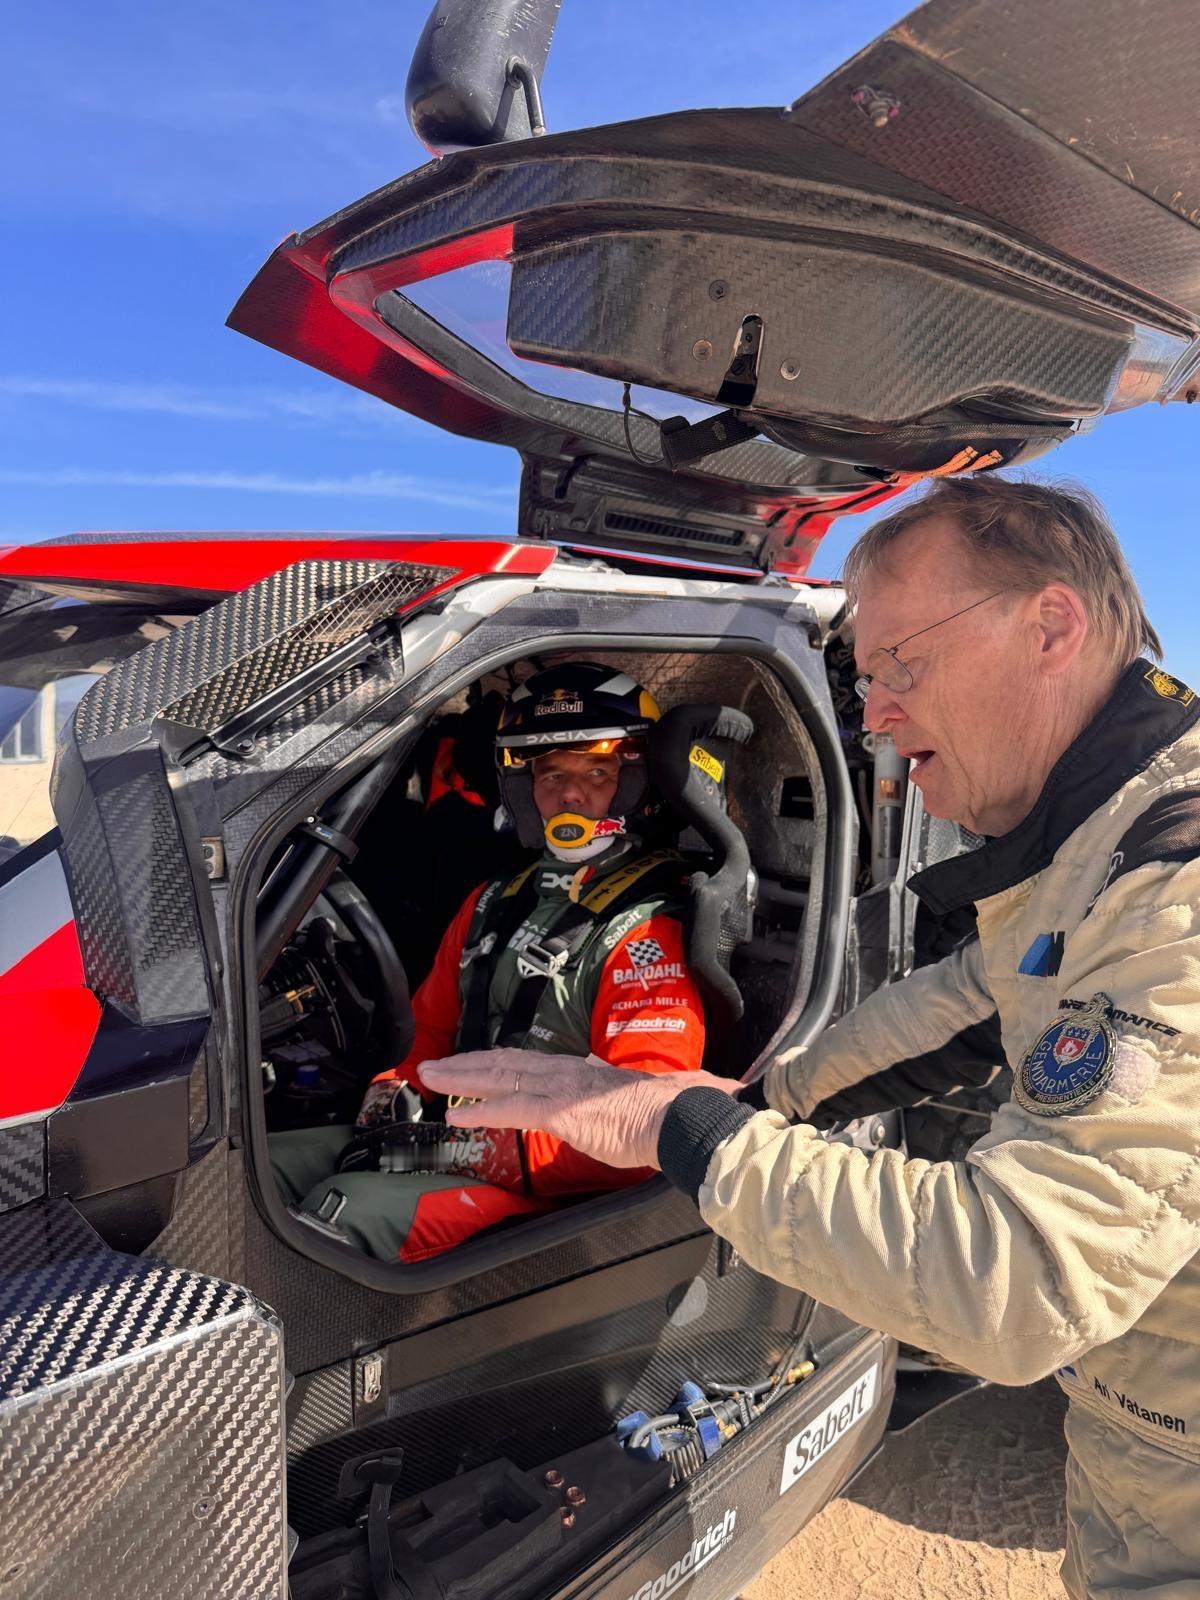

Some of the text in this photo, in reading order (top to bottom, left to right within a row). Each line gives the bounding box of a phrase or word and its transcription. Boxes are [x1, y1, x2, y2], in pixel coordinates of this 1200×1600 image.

[535, 701, 583, 716] Red Bull
[526, 731, 588, 744] DACIA
[693, 749, 721, 778] Sabelt
[604, 907, 642, 949] Sabelt
[613, 963, 685, 985] BARDAHL
[655, 997, 688, 1007] MILLE
[1030, 1040, 1102, 1094] GENDARMERIE
[1033, 1079, 1096, 1104] PRESIDENTIELLE
[1094, 1376, 1186, 1434] Ari Vatanen
[792, 1377, 868, 1475] Sabelt
[627, 1507, 738, 1600] Goodrich
